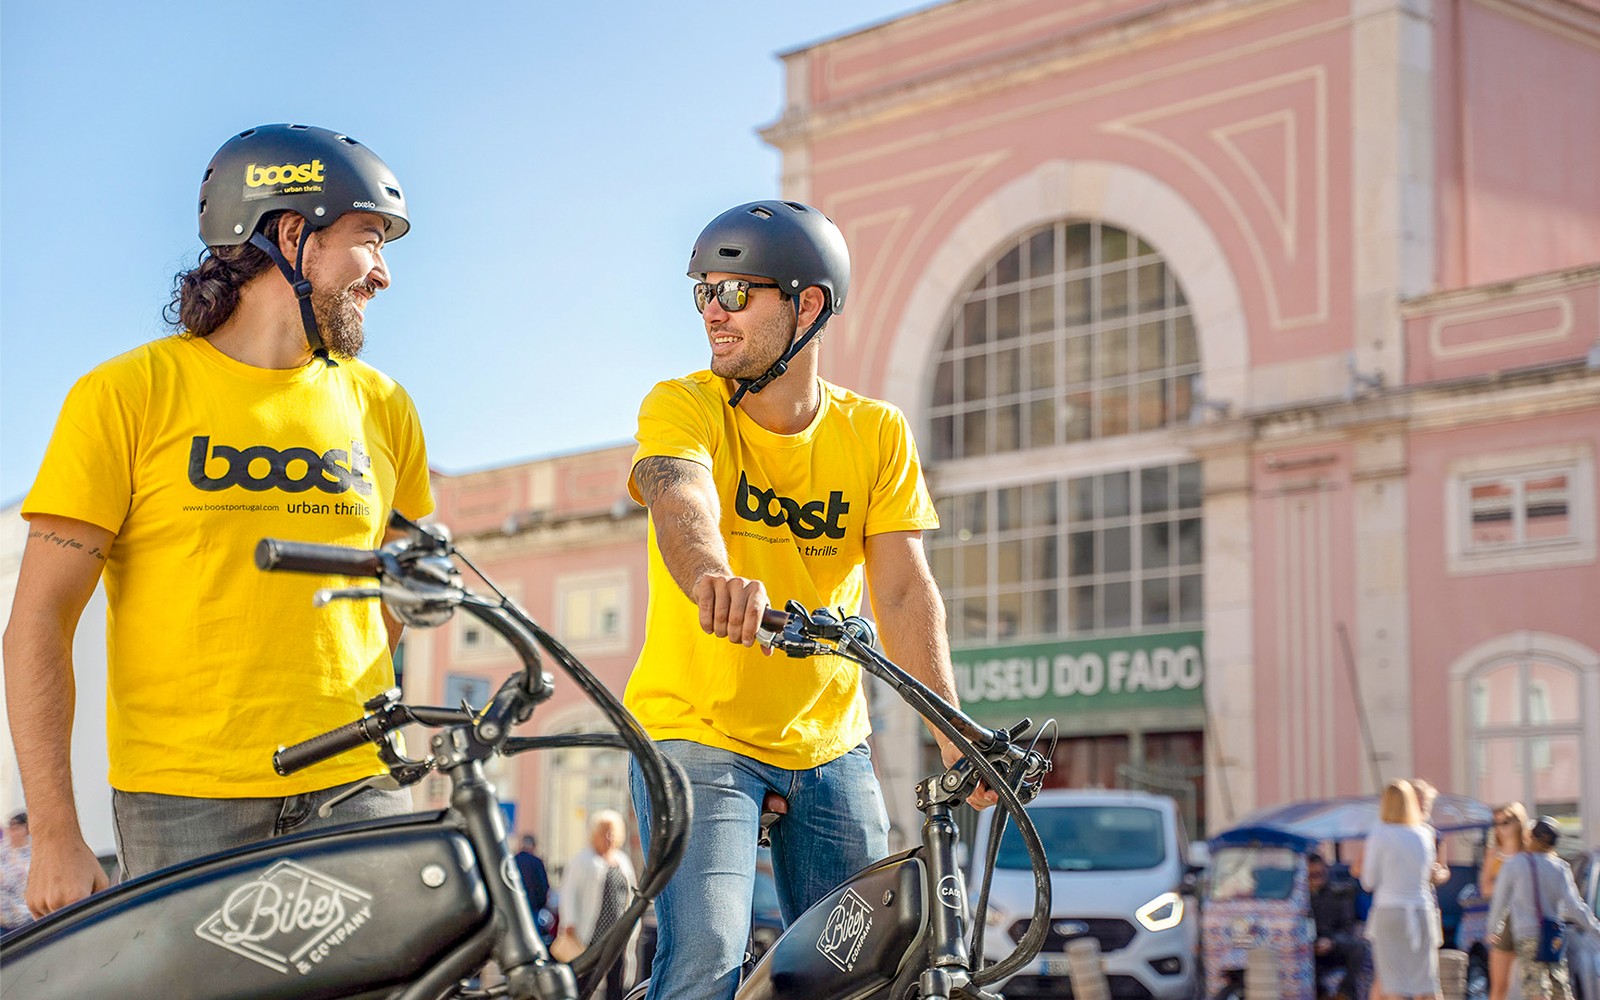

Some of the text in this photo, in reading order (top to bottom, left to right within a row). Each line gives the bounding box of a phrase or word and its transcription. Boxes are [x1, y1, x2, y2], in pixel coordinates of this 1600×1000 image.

[246, 160, 324, 187] boost
[188, 436, 372, 495] boost
[183, 501, 369, 515] www.boostportugal.com urban thrills
[735, 470, 849, 539] boost
[805, 546, 838, 556] thrills
[1053, 653, 1103, 697] DO
[1108, 646, 1202, 694] FADO
[223, 877, 344, 943] Bikes
[309, 906, 372, 964] COMPANY
[825, 899, 864, 953] Bikes
[851, 916, 874, 963] COMPANY
